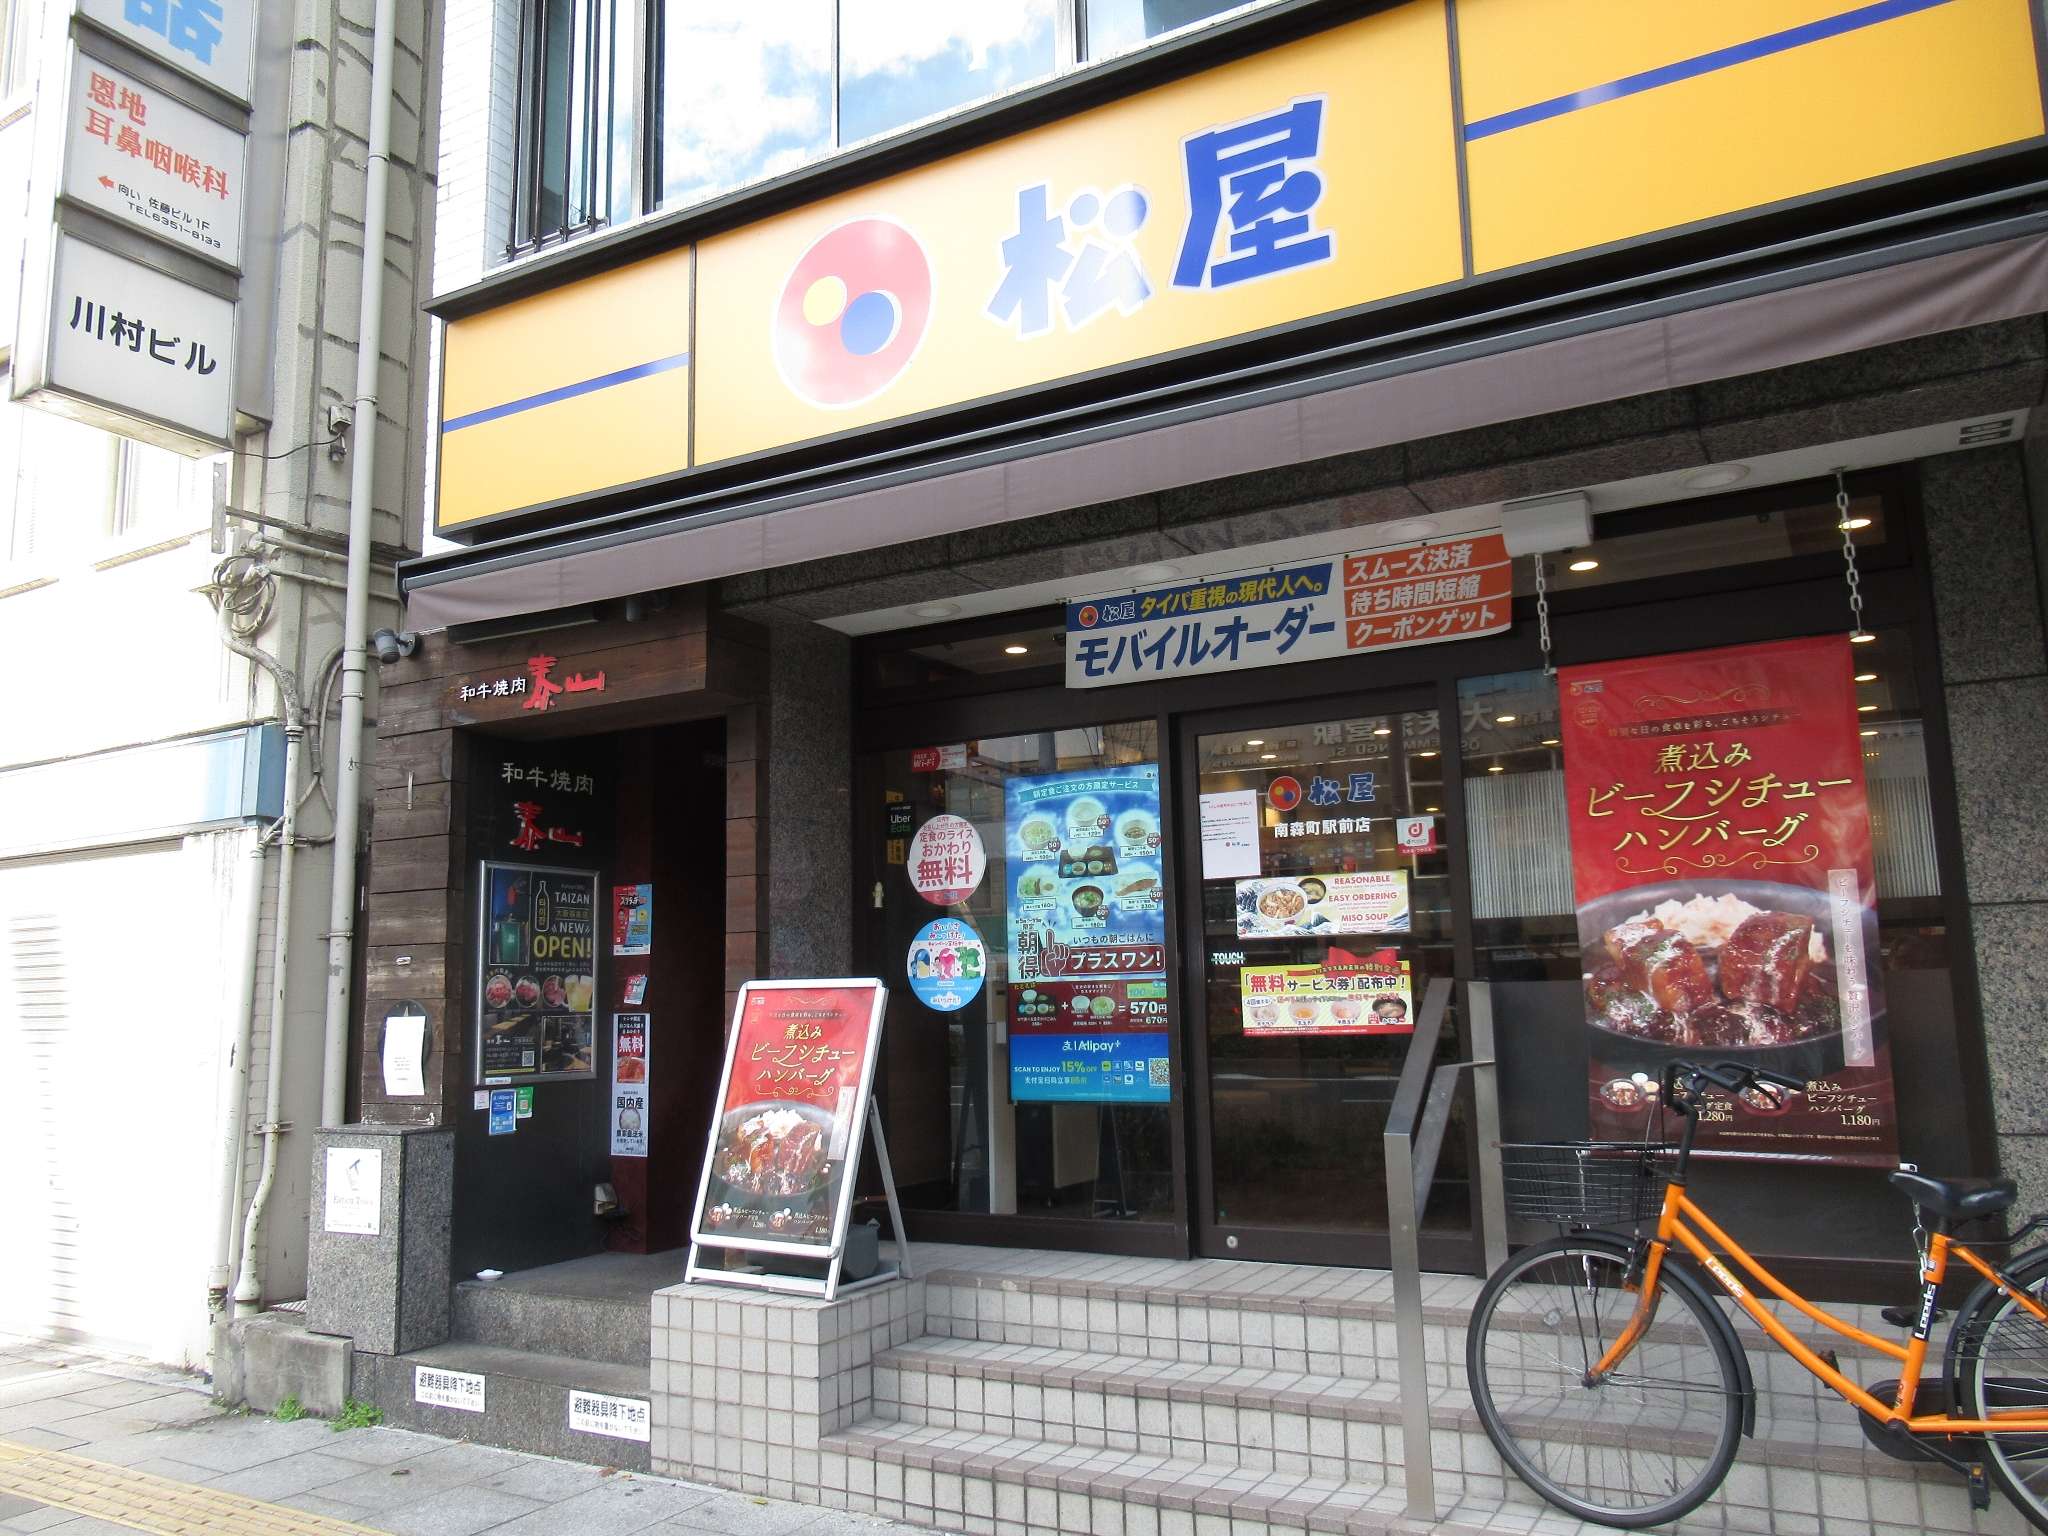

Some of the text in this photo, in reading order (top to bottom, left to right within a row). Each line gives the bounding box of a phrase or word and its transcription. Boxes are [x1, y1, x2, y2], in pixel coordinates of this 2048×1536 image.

[88, 71, 147, 126] 恩地
[85, 107, 229, 200] 耳鼻咽喉科
[118, 184, 142, 203] 向い
[987, 99, 1332, 335] 松屋
[70, 296, 217, 375] 川村ビル
[1349, 543, 1472, 584] スムーズ決済
[1351, 574, 1481, 616] 待ち時間短縮
[1102, 601, 1136, 622] 松屋
[1354, 605, 1496, 645] クーポンゲット
[1075, 602, 1336, 677] モバイルオーダー
[1654, 742, 1752, 774] 煮込み
[1307, 772, 1376, 806] 松屋
[1588, 774, 1852, 820] ビーフシチュー
[890, 814, 911, 823] Uber
[1274, 817, 1371, 838] 南森町駅前店
[919, 829, 974, 843] 定食のライス
[1613, 812, 1809, 853] ハンバーグ
[922, 841, 971, 857] おかわり
[917, 855, 973, 887] 無料
[1334, 874, 1391, 885] REASONABLE
[554, 891, 590, 905] TAIZAN
[1328, 891, 1398, 903] EASY ORDERING
[1341, 912, 1389, 922] MISO SOUP
[559, 921, 585, 934] NEW
[533, 935, 592, 958] OPEN!
[1073, 933, 1154, 944] いつもの朝ごはんに
[1017, 931, 1040, 979] 朝得
[1213, 952, 1244, 965] TOUCH
[1130, 1001, 1168, 1014] 570円
[1145, 1016, 1168, 1024] 670円
[783, 1023, 822, 1040] 煮込み
[619, 1035, 643, 1053] 無料
[751, 1042, 855, 1067] ビーフシチュー
[1061, 1061, 1085, 1073] 15%
[756, 1068, 835, 1086] ハンバーグ
[1805, 1080, 1842, 1093] 煮込み
[616, 1097, 643, 1109] 国内産
[1807, 1093, 1877, 1103] ビーフシチュー
[1808, 1104, 1865, 1113] ハンバーグ
[1914, 1283, 1937, 1339] Leeds
